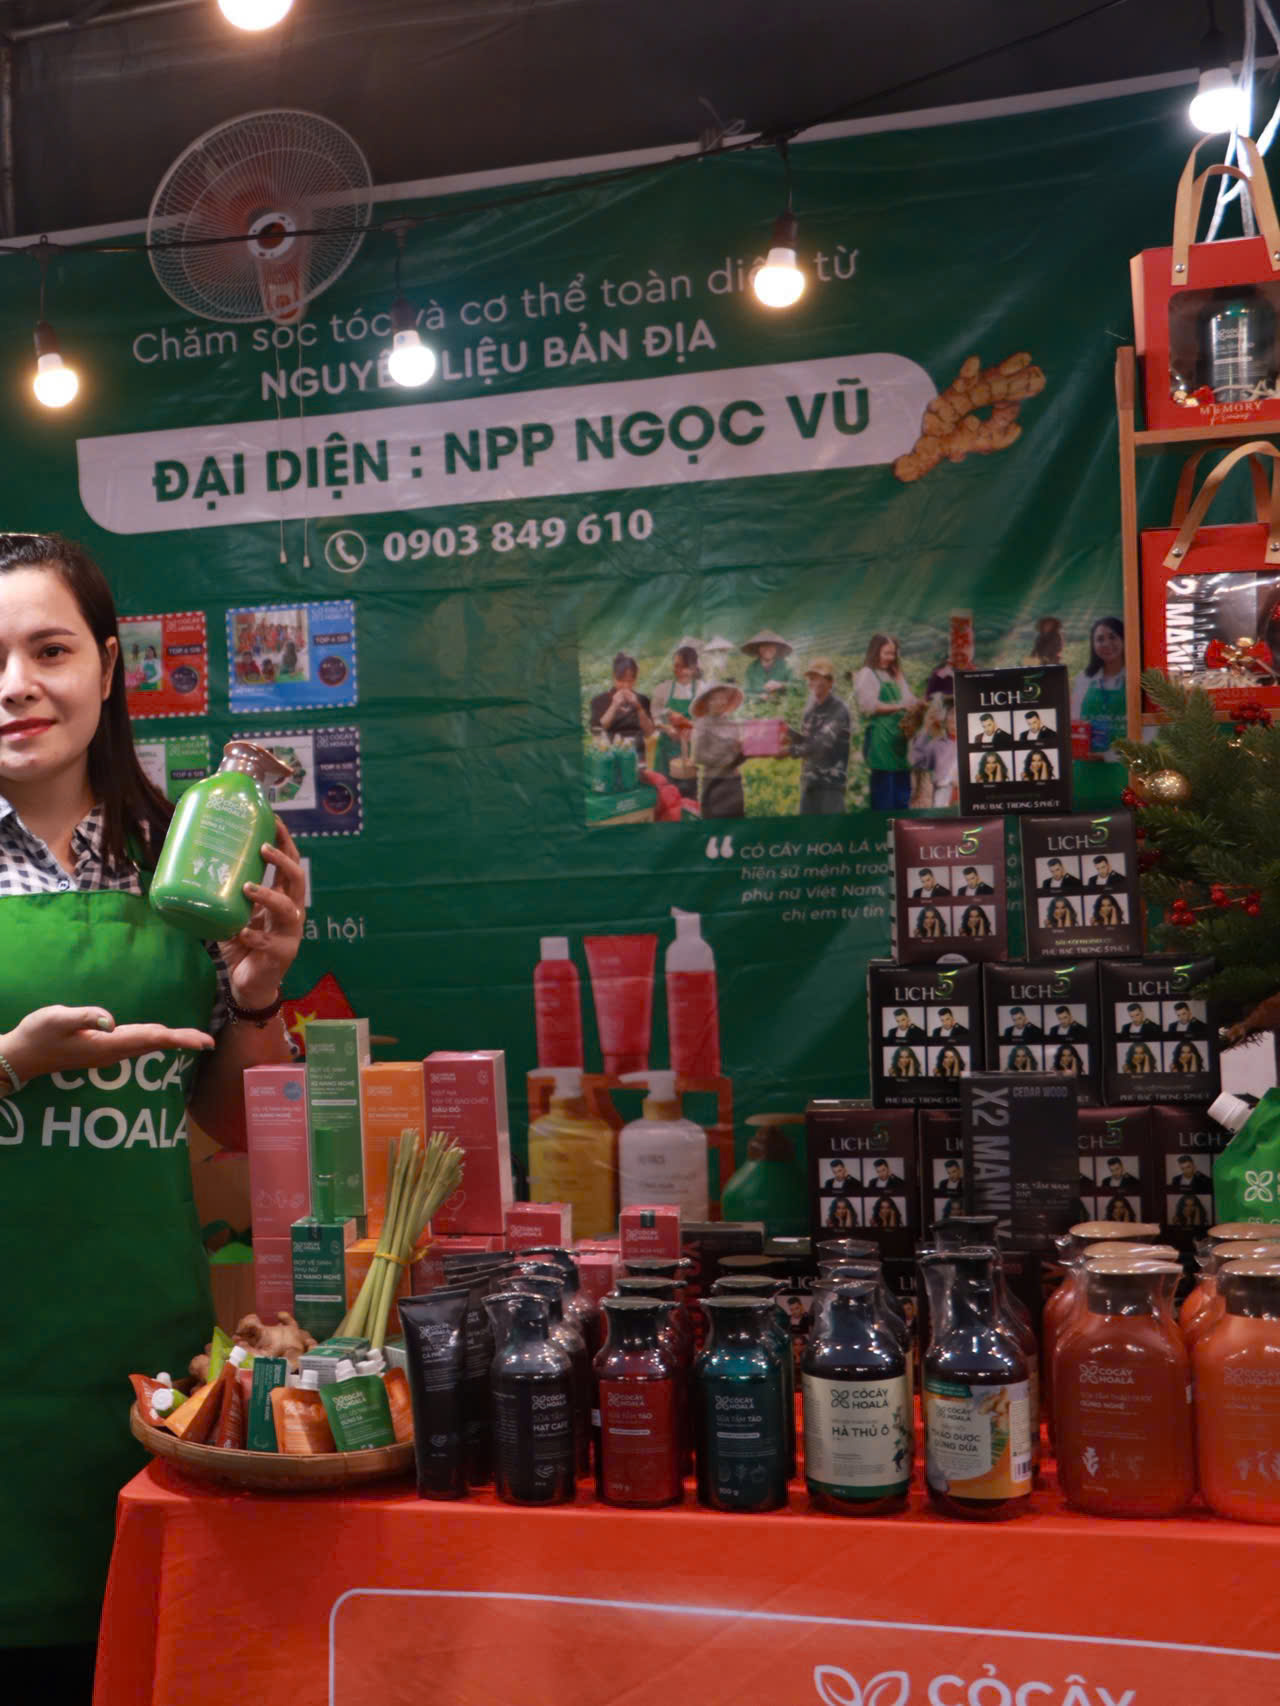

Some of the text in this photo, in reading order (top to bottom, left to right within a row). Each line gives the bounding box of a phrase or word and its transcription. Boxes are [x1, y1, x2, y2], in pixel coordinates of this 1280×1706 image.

[132, 327, 238, 363] Chăm
[329, 308, 392, 343] tóc
[460, 297, 508, 326] cơ
[521, 274, 587, 320] thể
[600, 262, 693, 307] toàn
[811, 245, 859, 283] từ
[440, 330, 529, 385] LIỆU
[543, 322, 629, 369] BẢN
[643, 318, 717, 364] ĐỊA
[152, 453, 245, 511] ĐẠI
[265, 431, 389, 501] DIỆN
[444, 421, 554, 476] NPP
[575, 400, 765, 466] NGỌC
[786, 377, 870, 440] VŨ
[382, 508, 653, 562] 0903 849 610
[806, 842, 844, 856] HOA
[810, 908, 837, 920] em
[863, 905, 885, 917] tin
[327, 915, 366, 944] hội
[1012, 1086, 1068, 1098] CEDAR WOOD
[832, 1423, 890, 1437] HÀ THỦ Ô
